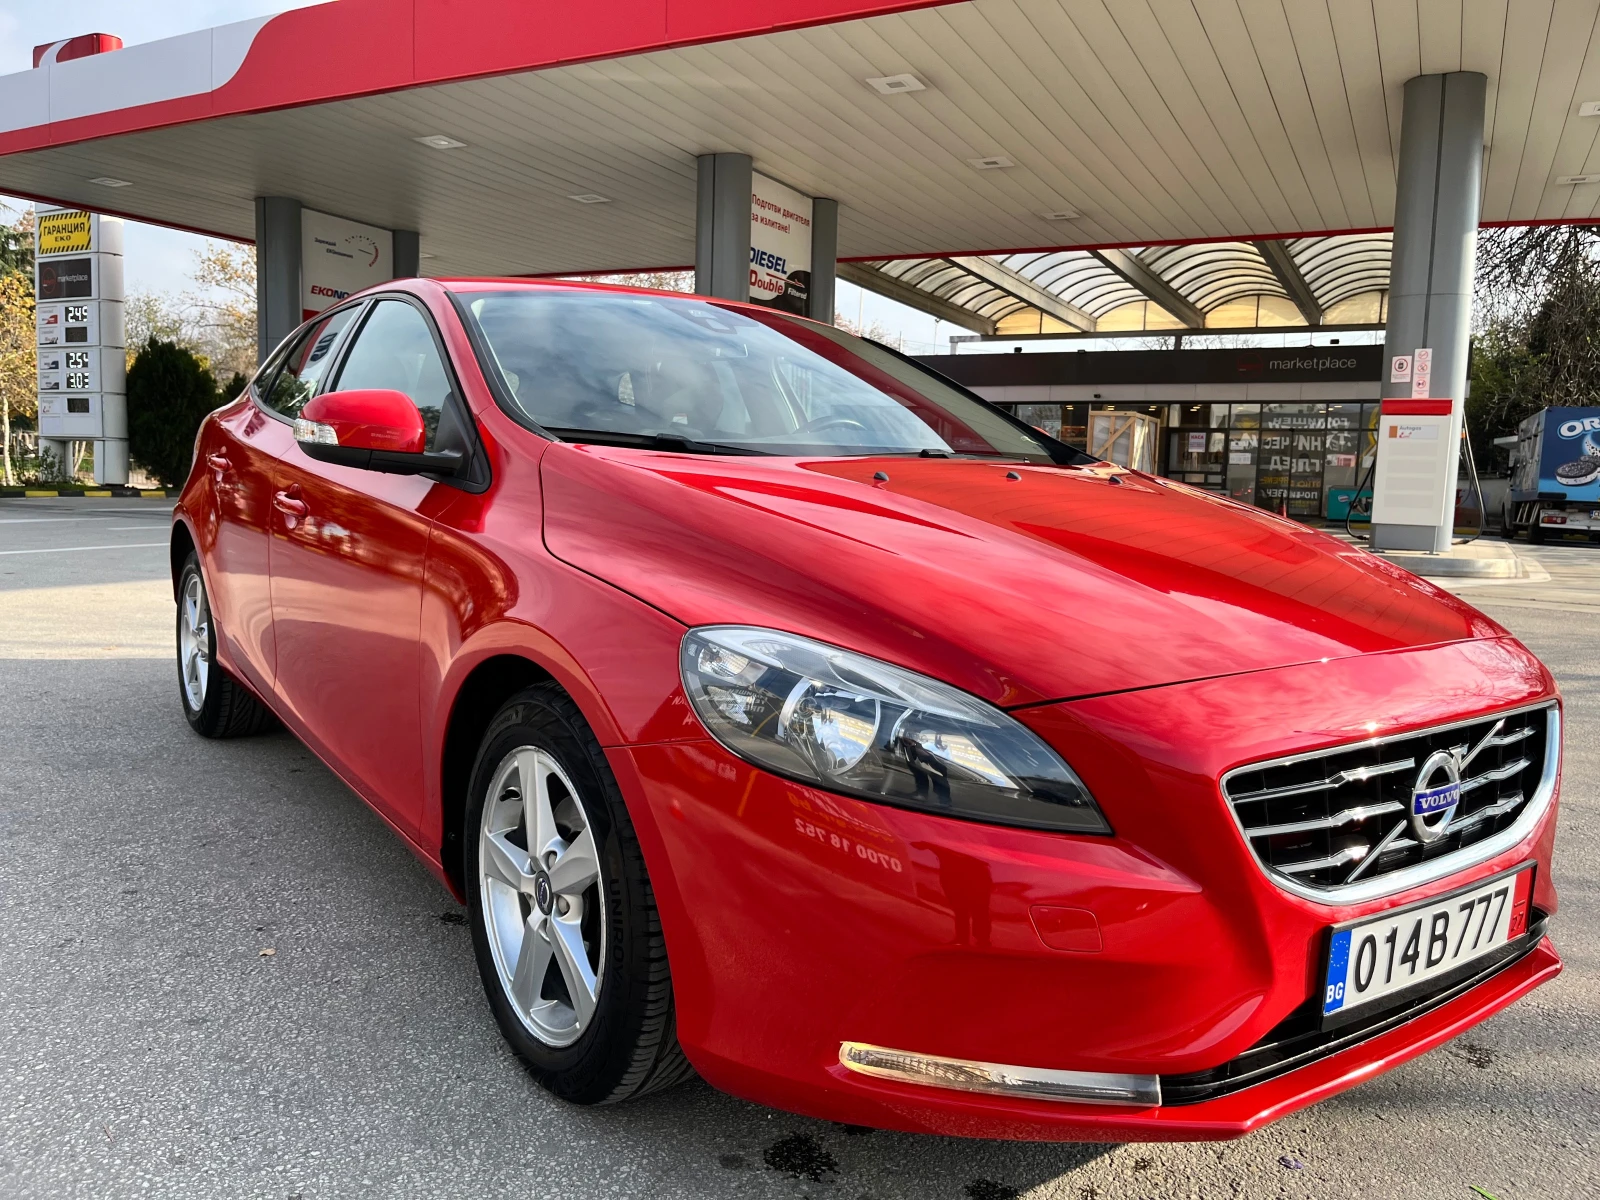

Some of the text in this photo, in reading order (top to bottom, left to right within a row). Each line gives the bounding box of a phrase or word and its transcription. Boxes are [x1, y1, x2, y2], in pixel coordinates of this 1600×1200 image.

[752, 194, 810, 227] Подготви двигателя
[43, 222, 85, 236] ГАРАНЦИЯ
[751, 213, 790, 234] за излитане!
[750, 247, 788, 274] DIESEL
[57, 274, 88, 283] marketplace
[750, 269, 784, 295] Double
[788, 287, 807, 300] Filtered
[1269, 357, 1357, 371] marketplace
[1419, 788, 1460, 810] VOLVO
[1354, 888, 1510, 993] 014B777
[1326, 984, 1344, 1004] BG
